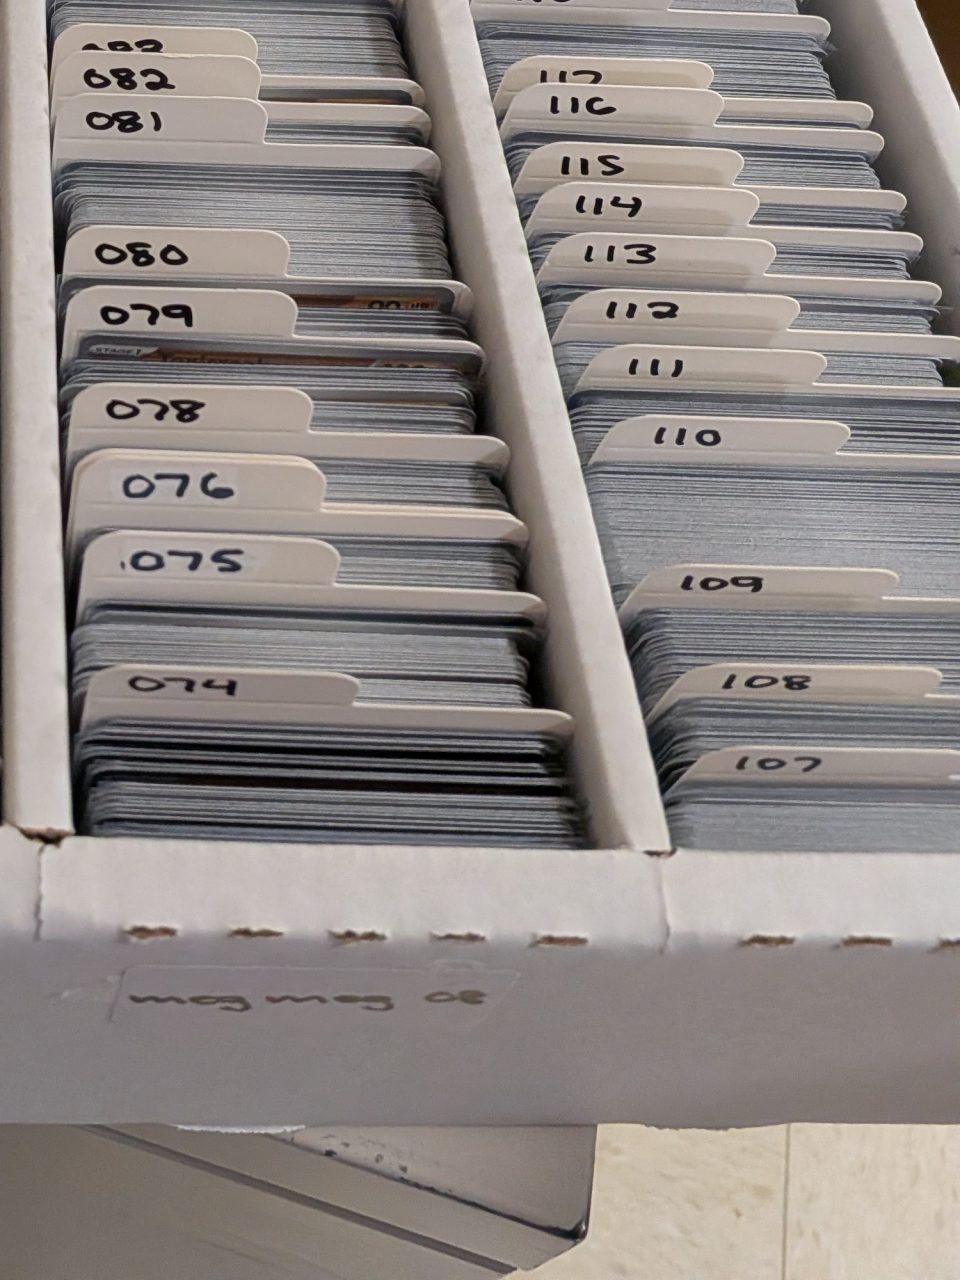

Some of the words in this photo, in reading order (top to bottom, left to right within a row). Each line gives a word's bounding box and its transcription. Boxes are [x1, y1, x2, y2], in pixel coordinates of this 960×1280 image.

[83, 68, 176, 91] 082
[550, 95, 617, 116] 116
[86, 111, 162, 133] 081
[560, 155, 625, 176] 115
[575, 195, 642, 217] 114
[95, 243, 189, 267] 080
[584, 244, 657, 264] 113
[100, 304, 194, 328] 079
[605, 301, 680, 319] 112
[628, 358, 683, 377] 111
[106, 398, 205, 423] 078
[653, 427, 722, 446] 110
[123, 472, 235, 499] 076
[129, 549, 245, 573] 075
[681, 575, 763, 593] 109
[128, 675, 238, 698] 074
[722, 674, 812, 690] 108
[736, 755, 822, 772] 107
